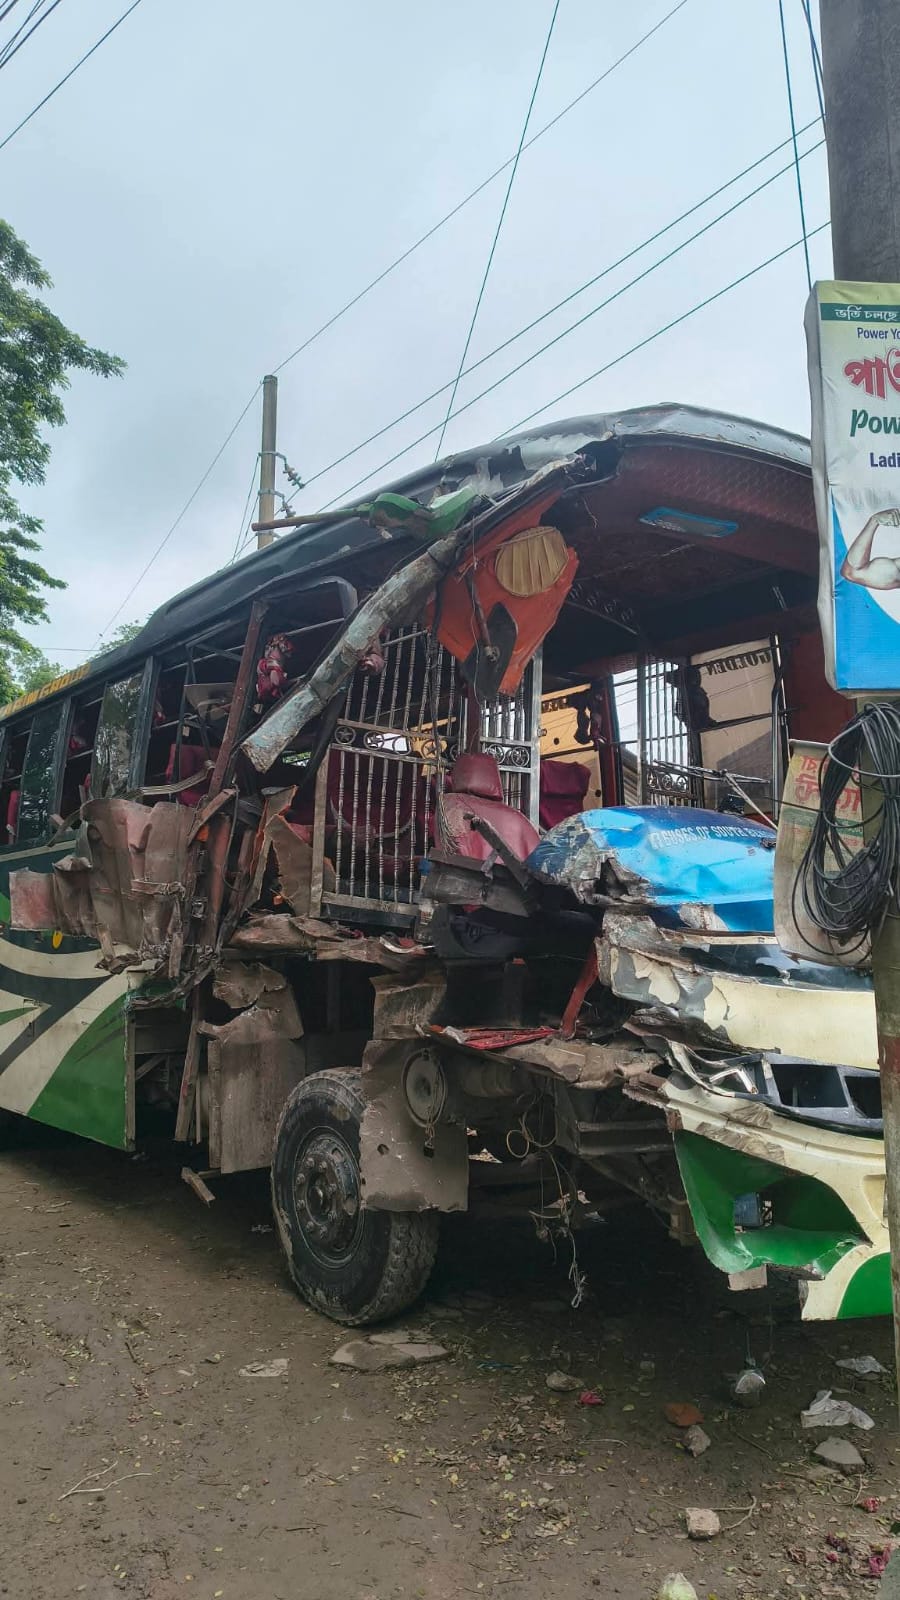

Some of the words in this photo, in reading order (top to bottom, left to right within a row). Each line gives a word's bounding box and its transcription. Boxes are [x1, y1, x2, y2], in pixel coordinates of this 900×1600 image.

[835, 305, 861, 320] ভর্তি
[864, 310, 898, 322] চলছে
[857, 327, 888, 339] Power
[870, 452, 900, 468] Ladi
